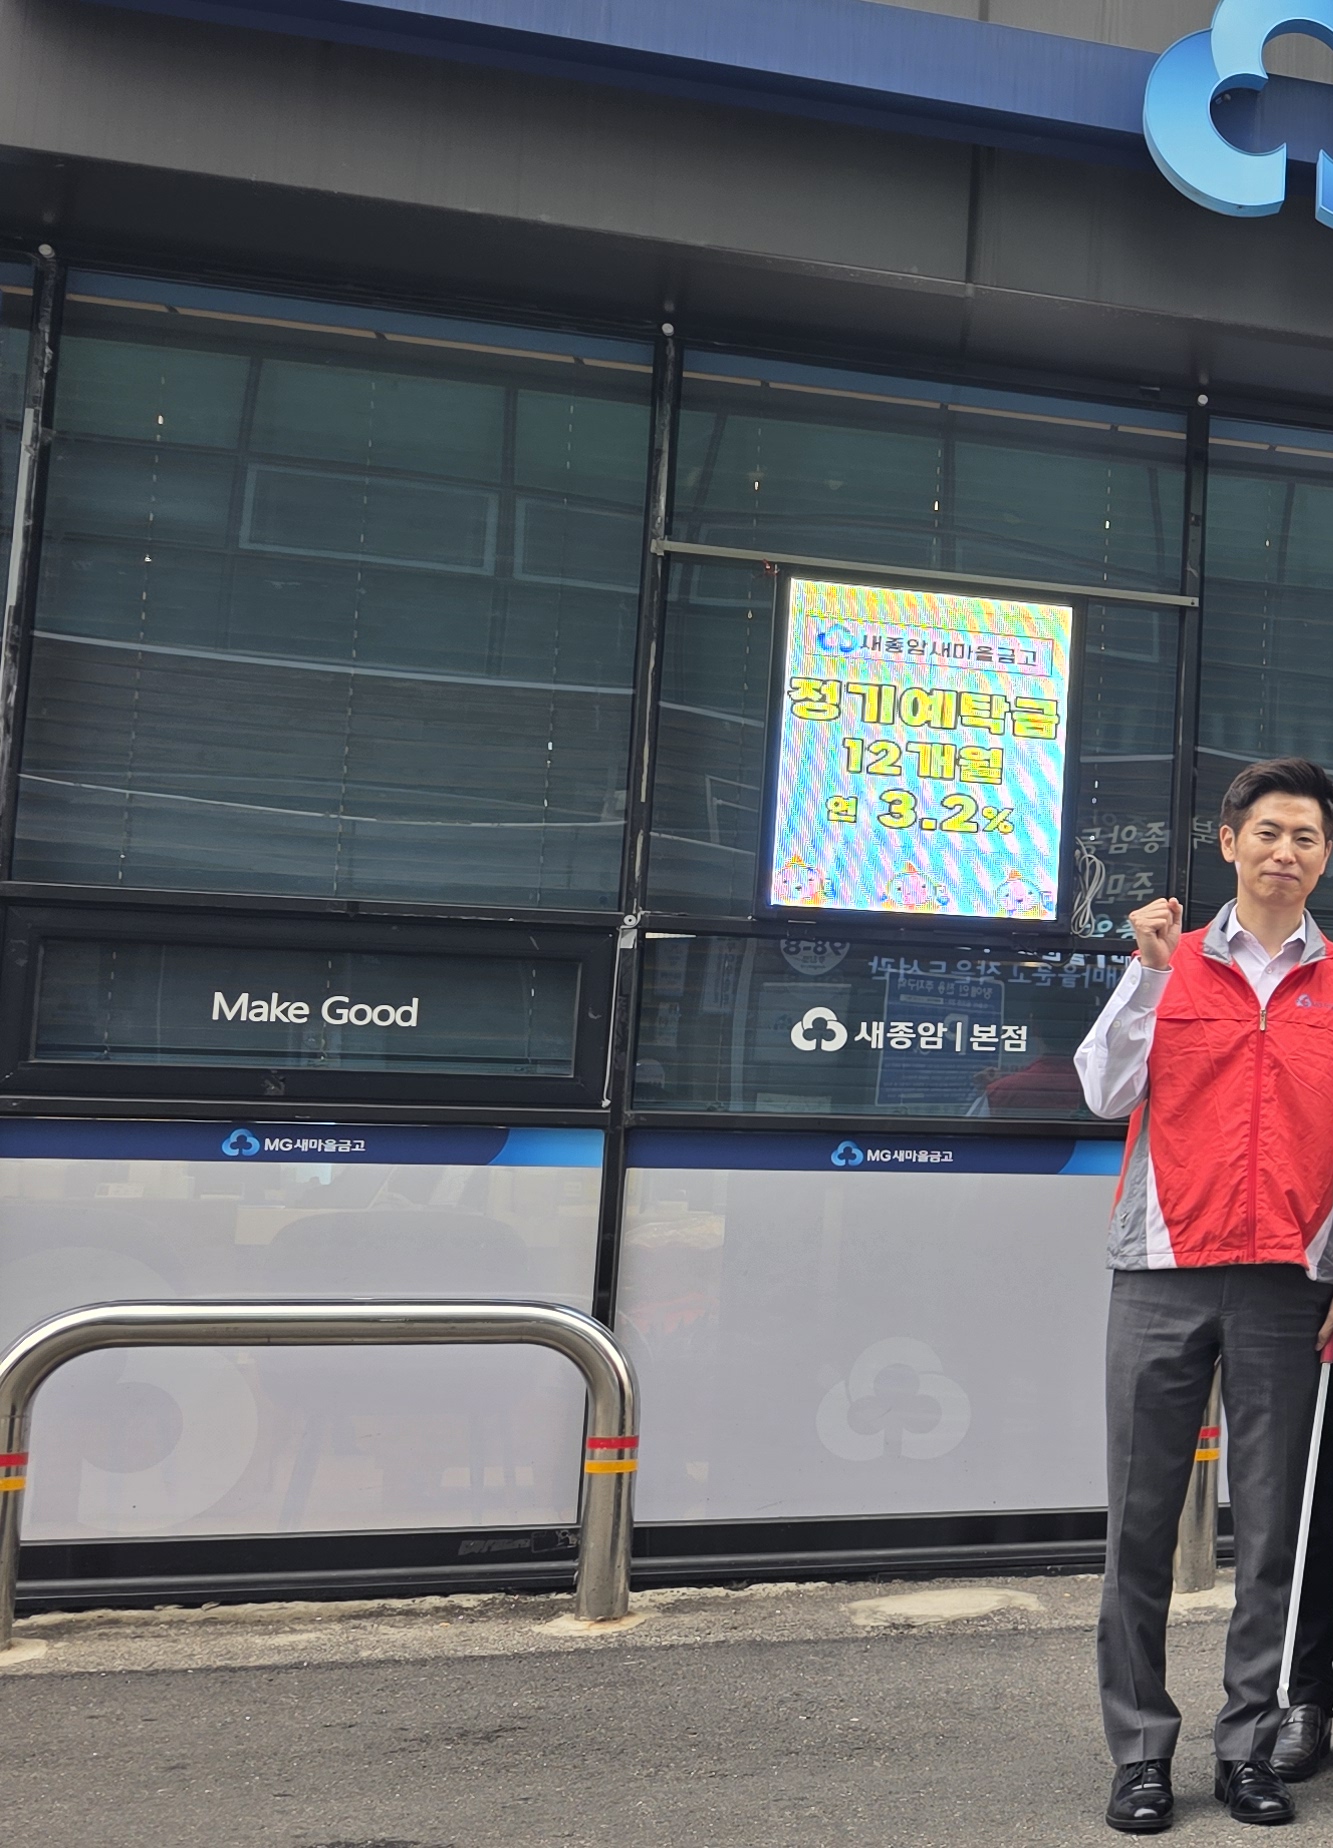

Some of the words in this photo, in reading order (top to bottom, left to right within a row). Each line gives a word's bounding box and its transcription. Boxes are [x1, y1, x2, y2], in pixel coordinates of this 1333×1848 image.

[860, 634, 1037, 667] 새종암새마을금고
[787, 677, 1060, 740] 정기예탁금
[843, 738, 1004, 785] 12개월
[825, 795, 857, 823] 연
[877, 789, 1014, 835] 3.2%
[212, 992, 310, 1024] Make
[321, 996, 419, 1028] Good
[854, 1019, 948, 1050] 새종암
[969, 1024, 1028, 1052] 본점
[264, 1138, 366, 1153] MG새마을금고
[866, 1148, 954, 1163] MG새마을금고
